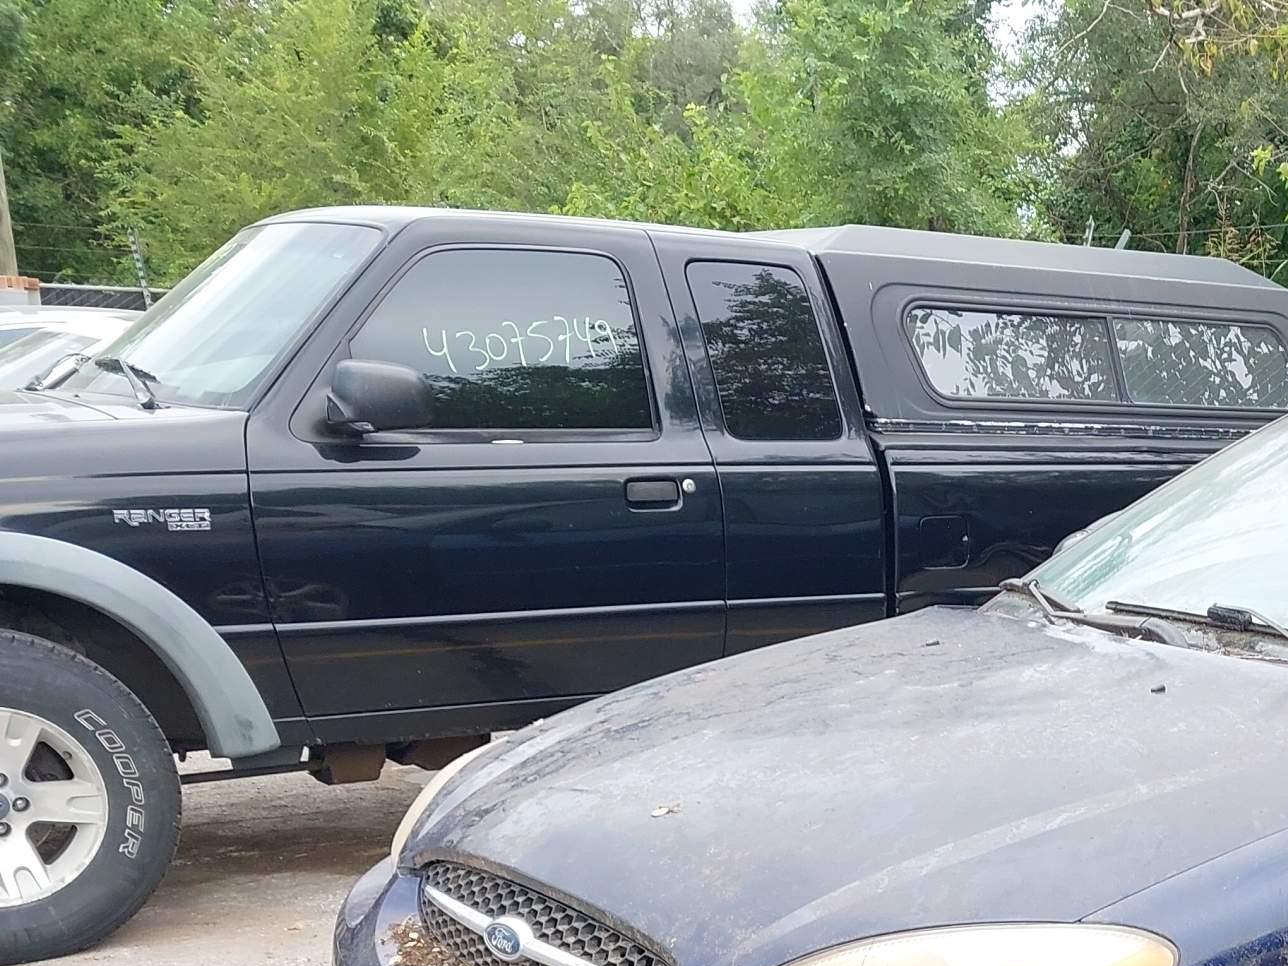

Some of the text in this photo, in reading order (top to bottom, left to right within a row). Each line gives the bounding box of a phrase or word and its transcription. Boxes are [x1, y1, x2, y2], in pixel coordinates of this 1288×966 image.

[422, 316, 619, 373] 43075749
[112, 508, 212, 527] RANGER
[73, 708, 145, 859] COOPER
[491, 927, 514, 953] Ford
